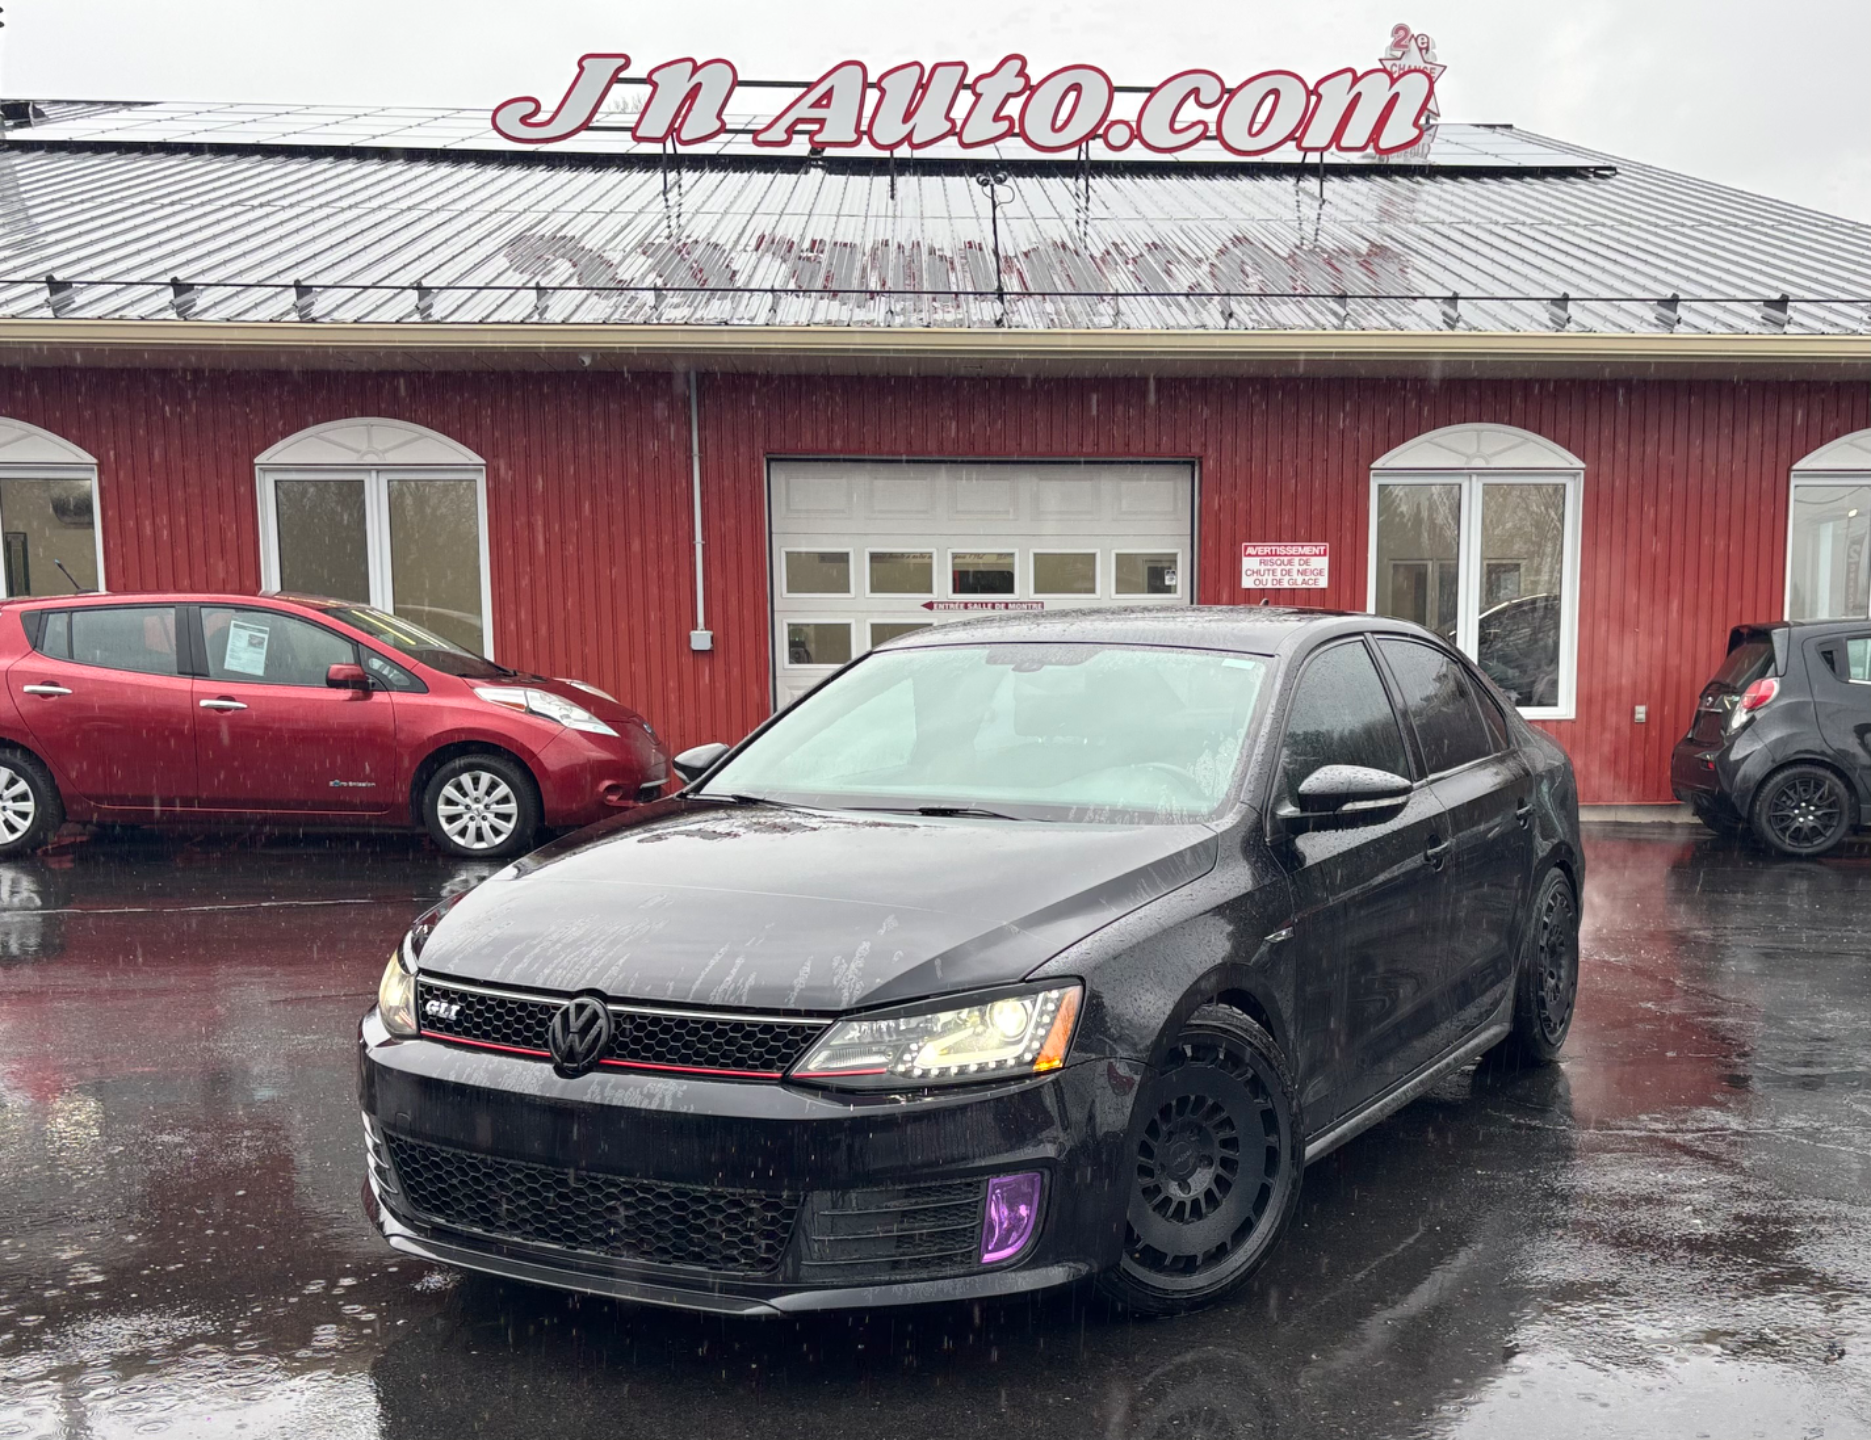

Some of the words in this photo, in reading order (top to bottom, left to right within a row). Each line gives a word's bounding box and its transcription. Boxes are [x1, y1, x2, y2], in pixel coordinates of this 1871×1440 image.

[491, 53, 738, 145] Jn
[752, 54, 1434, 156] Auto.com
[1245, 545, 1325, 555] AVERTISSEMENT
[1259, 558, 1295, 567] RISQUE
[1298, 558, 1311, 567] DE
[1245, 568, 1278, 577] CHUTE
[1280, 568, 1294, 577] DE
[1297, 568, 1325, 577] NEIGE
[1253, 578, 1268, 587] OU
[1271, 578, 1285, 587] DE
[1287, 578, 1320, 587] GLACE
[933, 601, 965, 610] ENTRÉE
[967, 602, 993, 610] SALLE
[995, 602, 1006, 610] DE
[1008, 602, 1043, 610] MONTRE
[425, 999, 461, 1021] GLI
